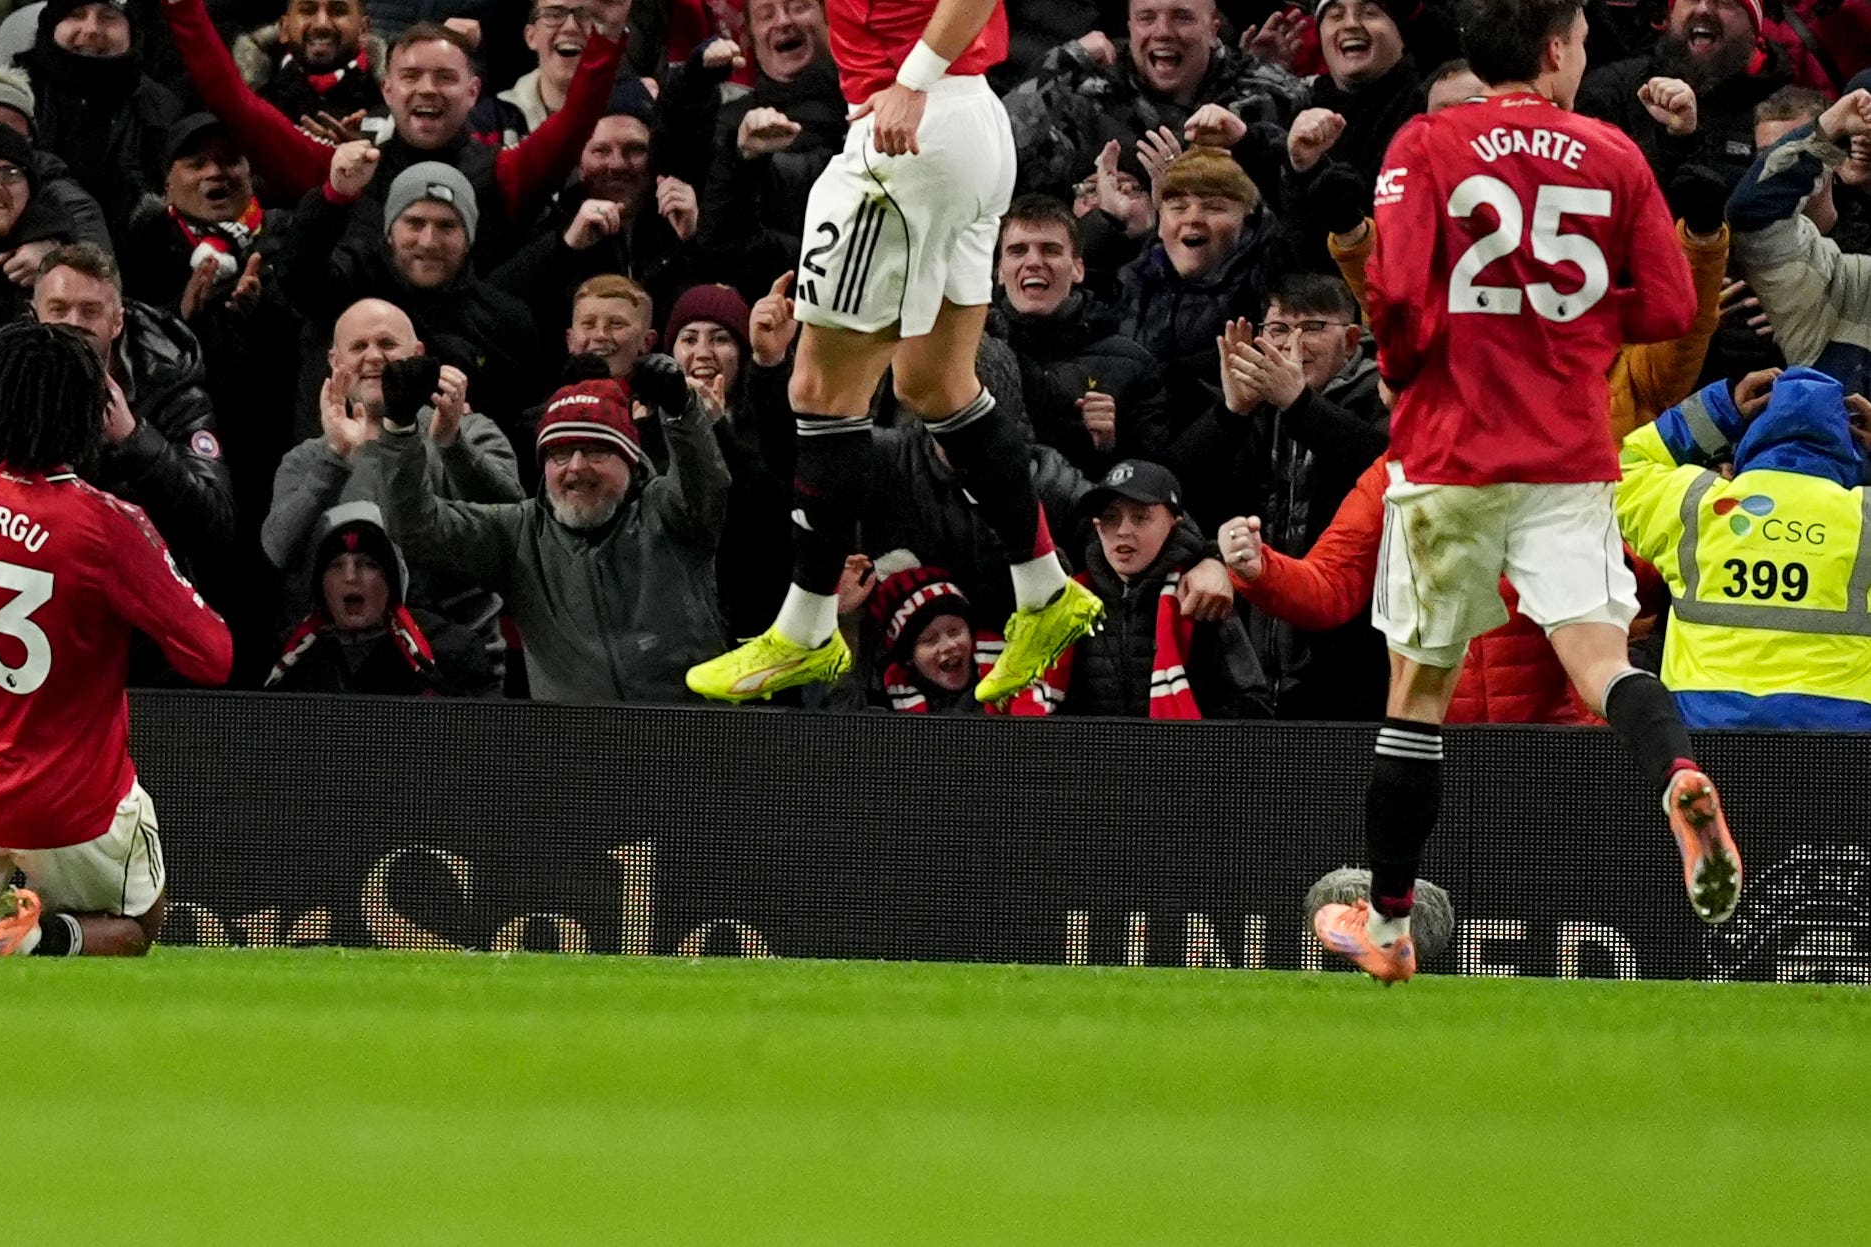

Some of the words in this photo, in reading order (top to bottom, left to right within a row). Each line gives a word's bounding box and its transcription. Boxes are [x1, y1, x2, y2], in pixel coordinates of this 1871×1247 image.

[1470, 127, 1587, 170] UGARTE
[1447, 174, 1612, 323] 25
[1762, 518, 1826, 545] CSG
[1722, 558, 1809, 602] 399
